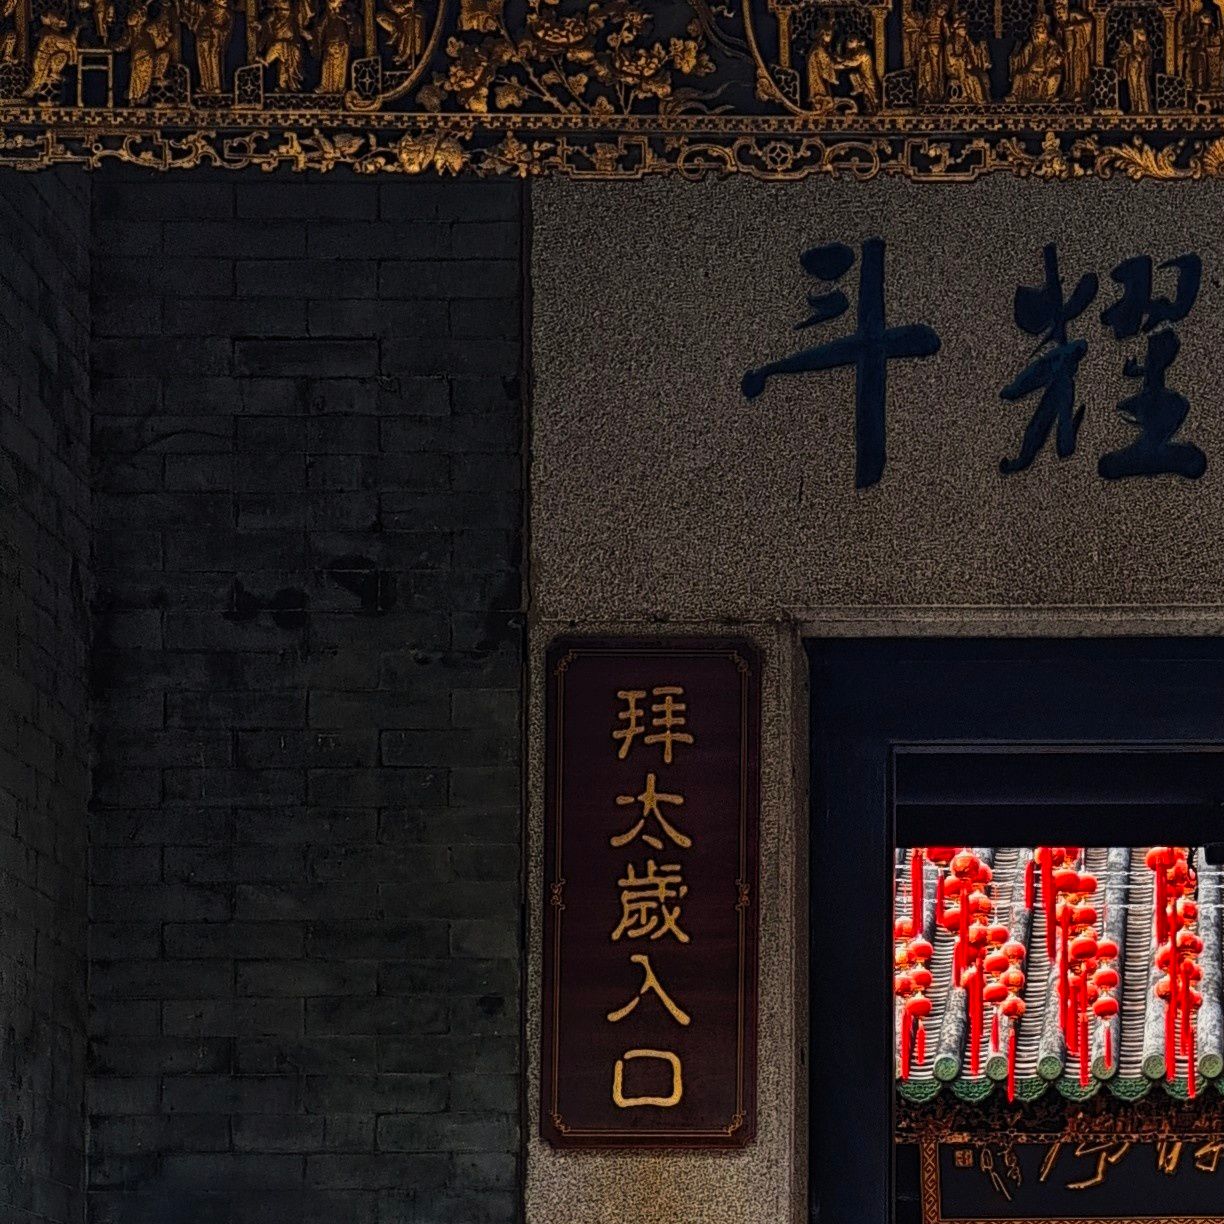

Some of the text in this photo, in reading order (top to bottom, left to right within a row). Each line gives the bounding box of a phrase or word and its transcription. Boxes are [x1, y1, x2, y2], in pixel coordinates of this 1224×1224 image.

[606, 685, 695, 1108] 拜太歲入口
